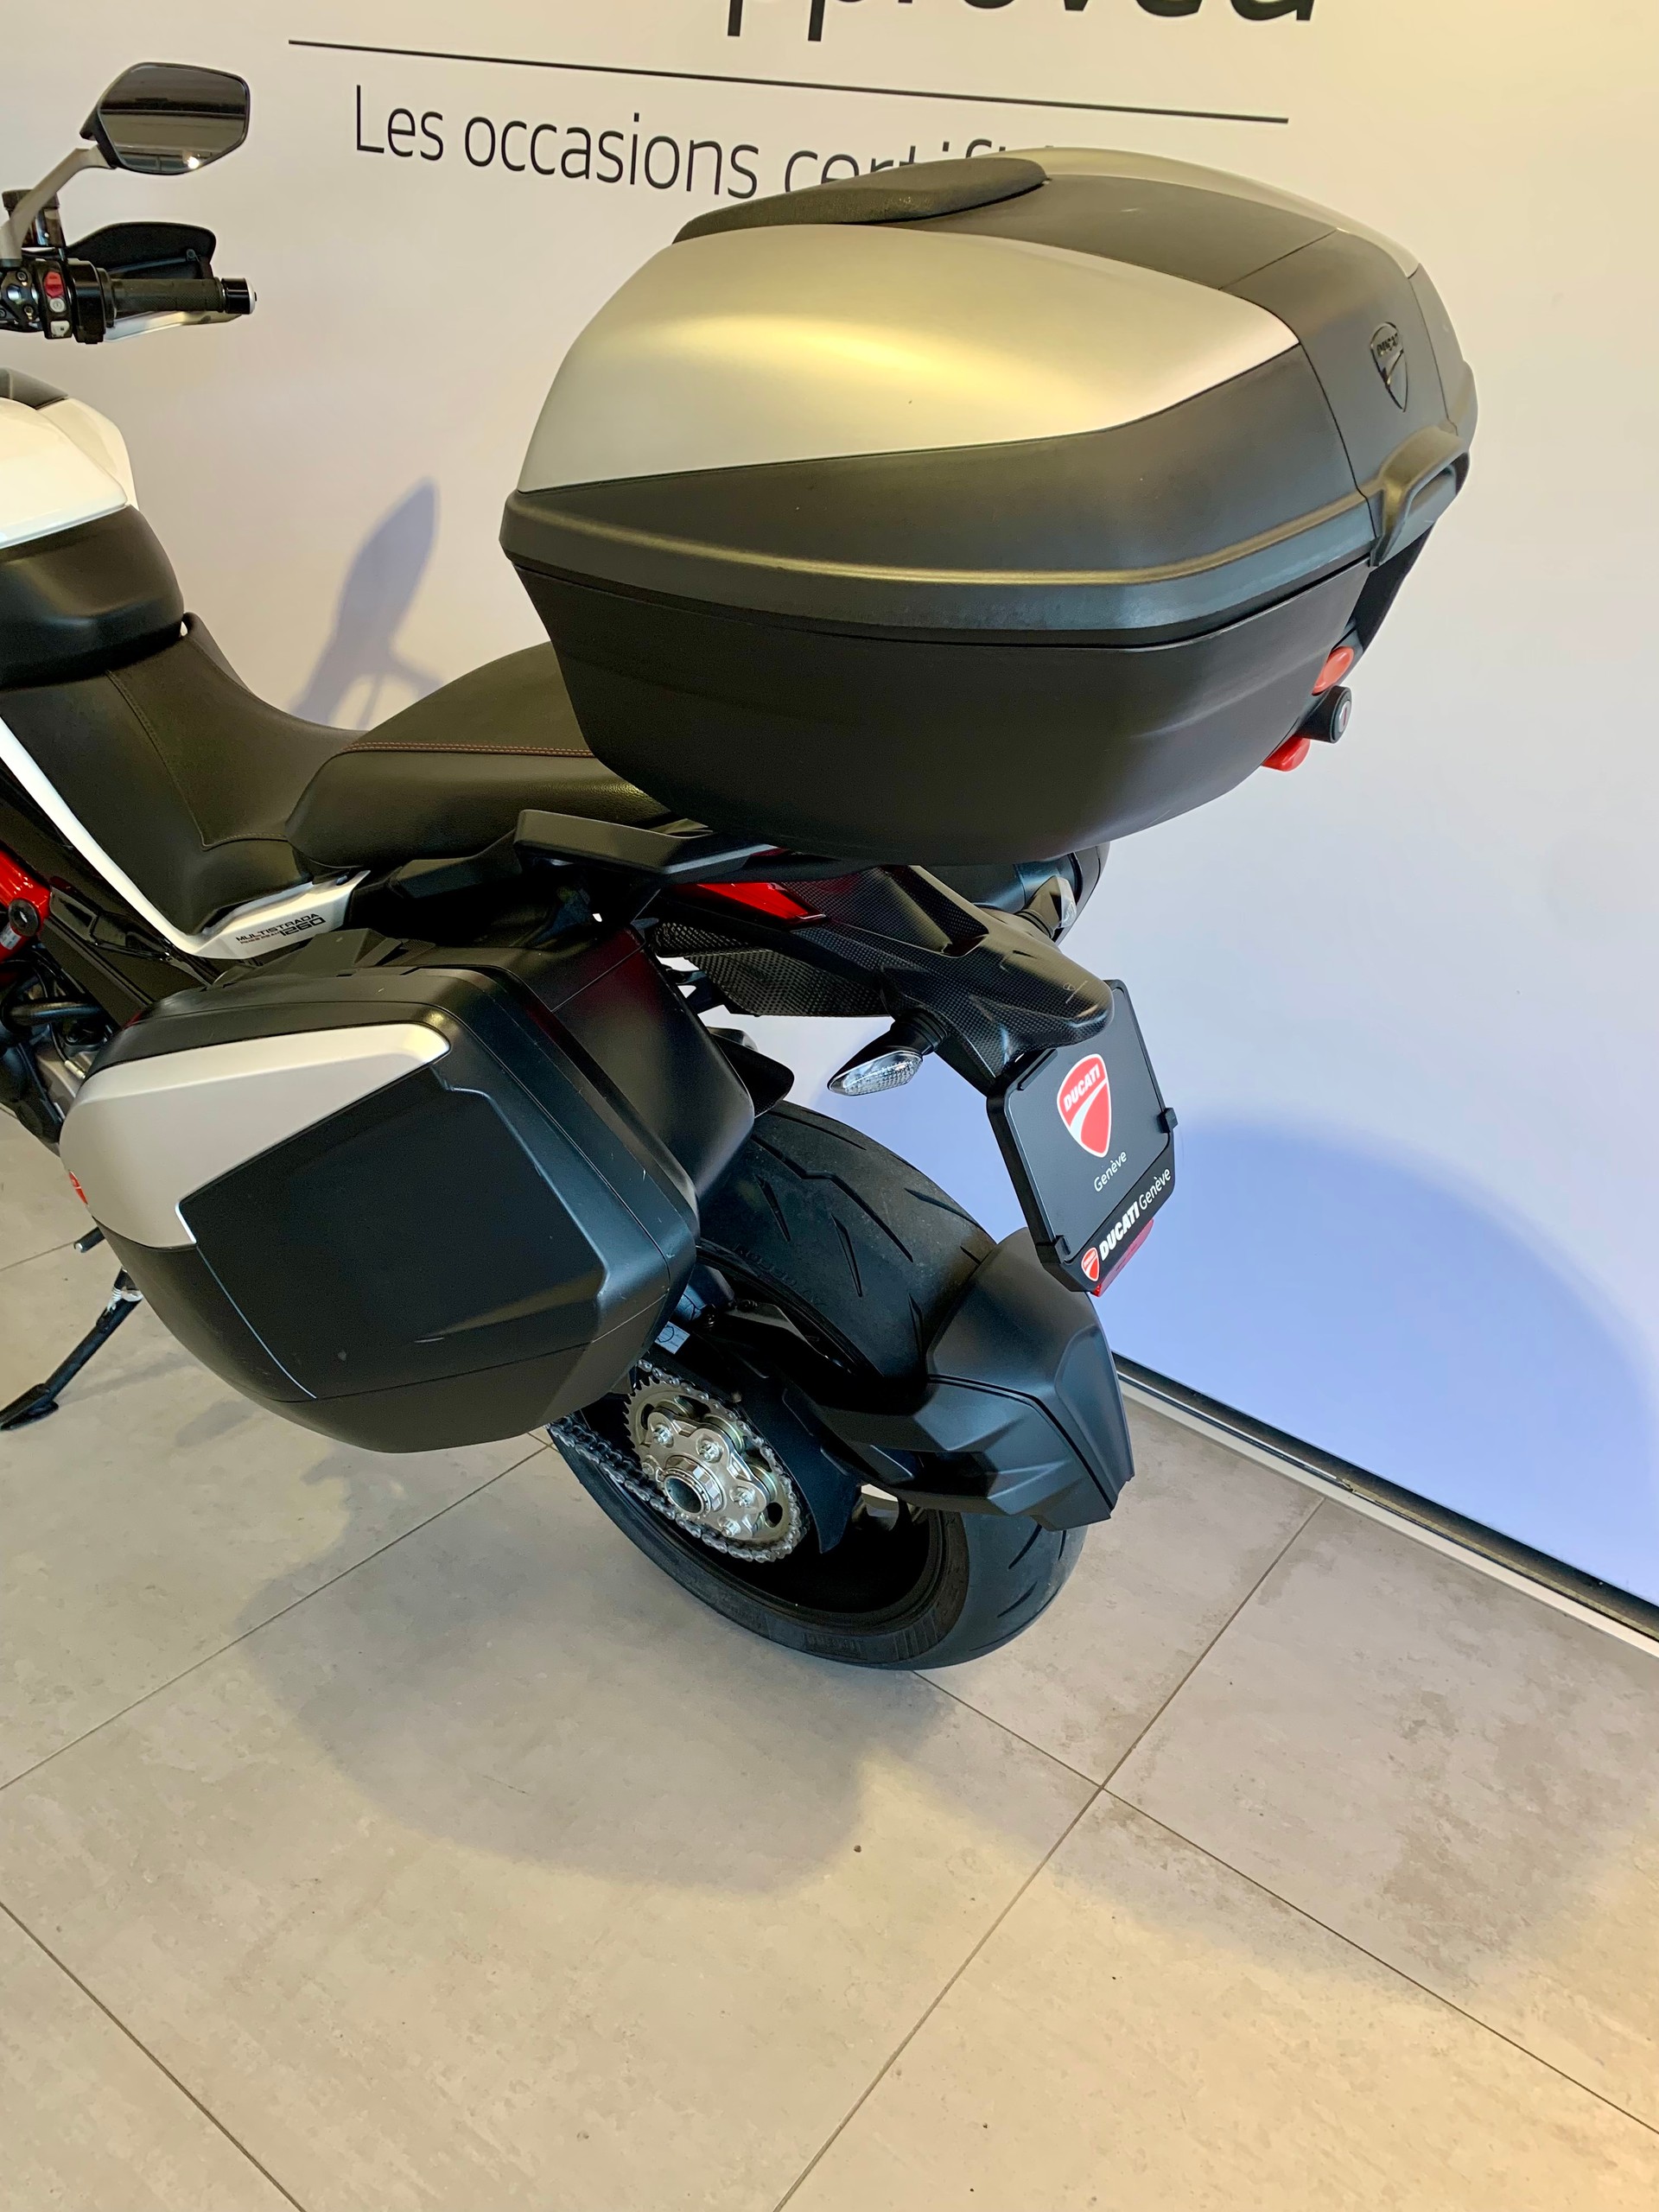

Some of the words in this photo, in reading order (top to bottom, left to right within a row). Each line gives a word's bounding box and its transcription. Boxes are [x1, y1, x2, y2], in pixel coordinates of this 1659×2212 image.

[355, 84, 444, 162] Les
[463, 111, 759, 200] occasions
[235, 913, 319, 941] MULTISTRADA
[278, 917, 326, 937] 1260
[1063, 1064, 1101, 1112] DUCATI
[1093, 1150, 1128, 1192] Genève
[1098, 1200, 1141, 1262] DUCATI
[1138, 1167, 1172, 1211] Genève
